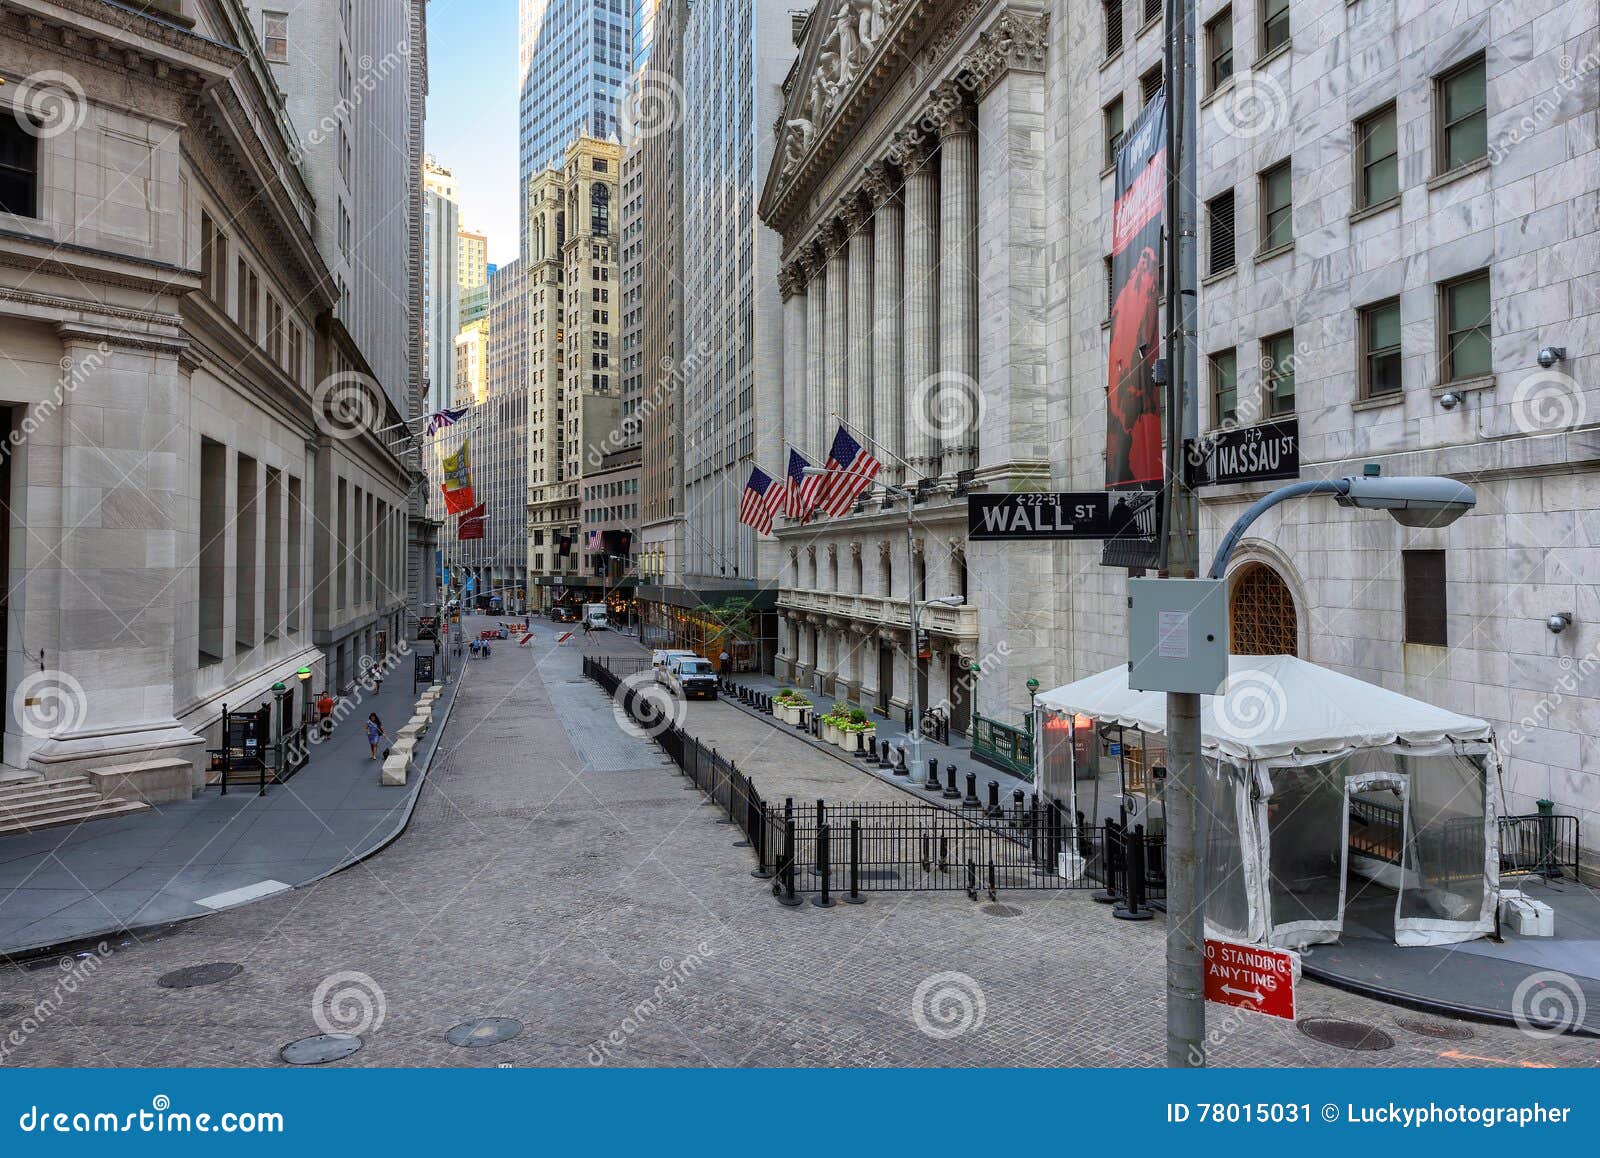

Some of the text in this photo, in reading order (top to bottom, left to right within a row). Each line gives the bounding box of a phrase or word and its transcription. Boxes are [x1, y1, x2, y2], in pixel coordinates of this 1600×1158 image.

[1220, 436, 1294, 475] NASSAU ST
[1027, 493, 1061, 506] 22-51
[982, 504, 1096, 532] WALL ST
[1222, 948, 1285, 973] STANDING
[1210, 964, 1276, 989] ANYTIME
